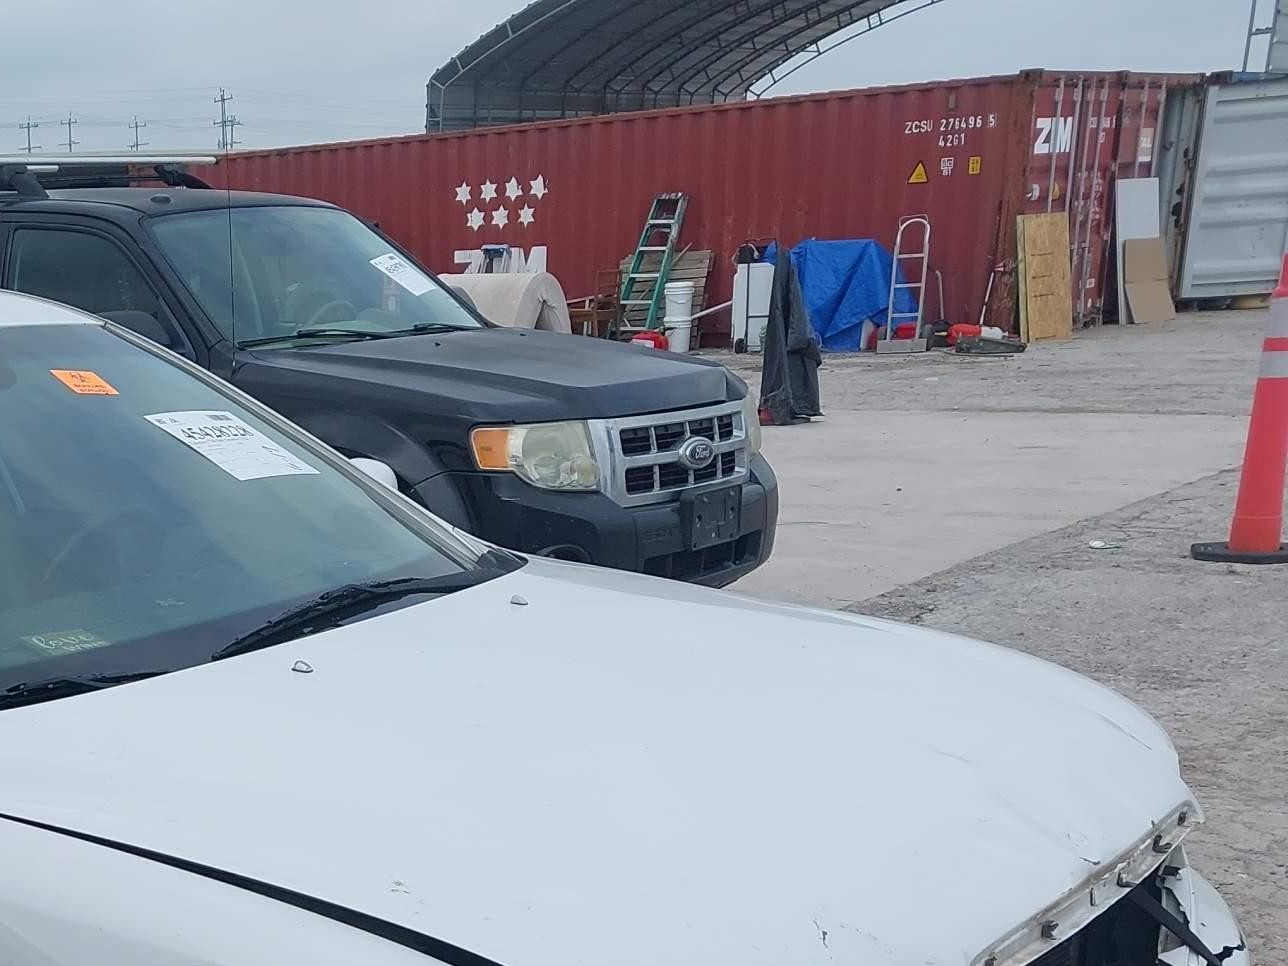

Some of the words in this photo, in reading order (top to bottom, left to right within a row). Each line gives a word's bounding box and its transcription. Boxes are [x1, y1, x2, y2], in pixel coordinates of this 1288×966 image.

[904, 120, 933, 134] ZCSU
[940, 115, 983, 131] 276496
[989, 113, 996, 127] 5
[1034, 116, 1073, 154] ZIM
[454, 245, 547, 274] ZM
[179, 424, 255, 442] 45428228
